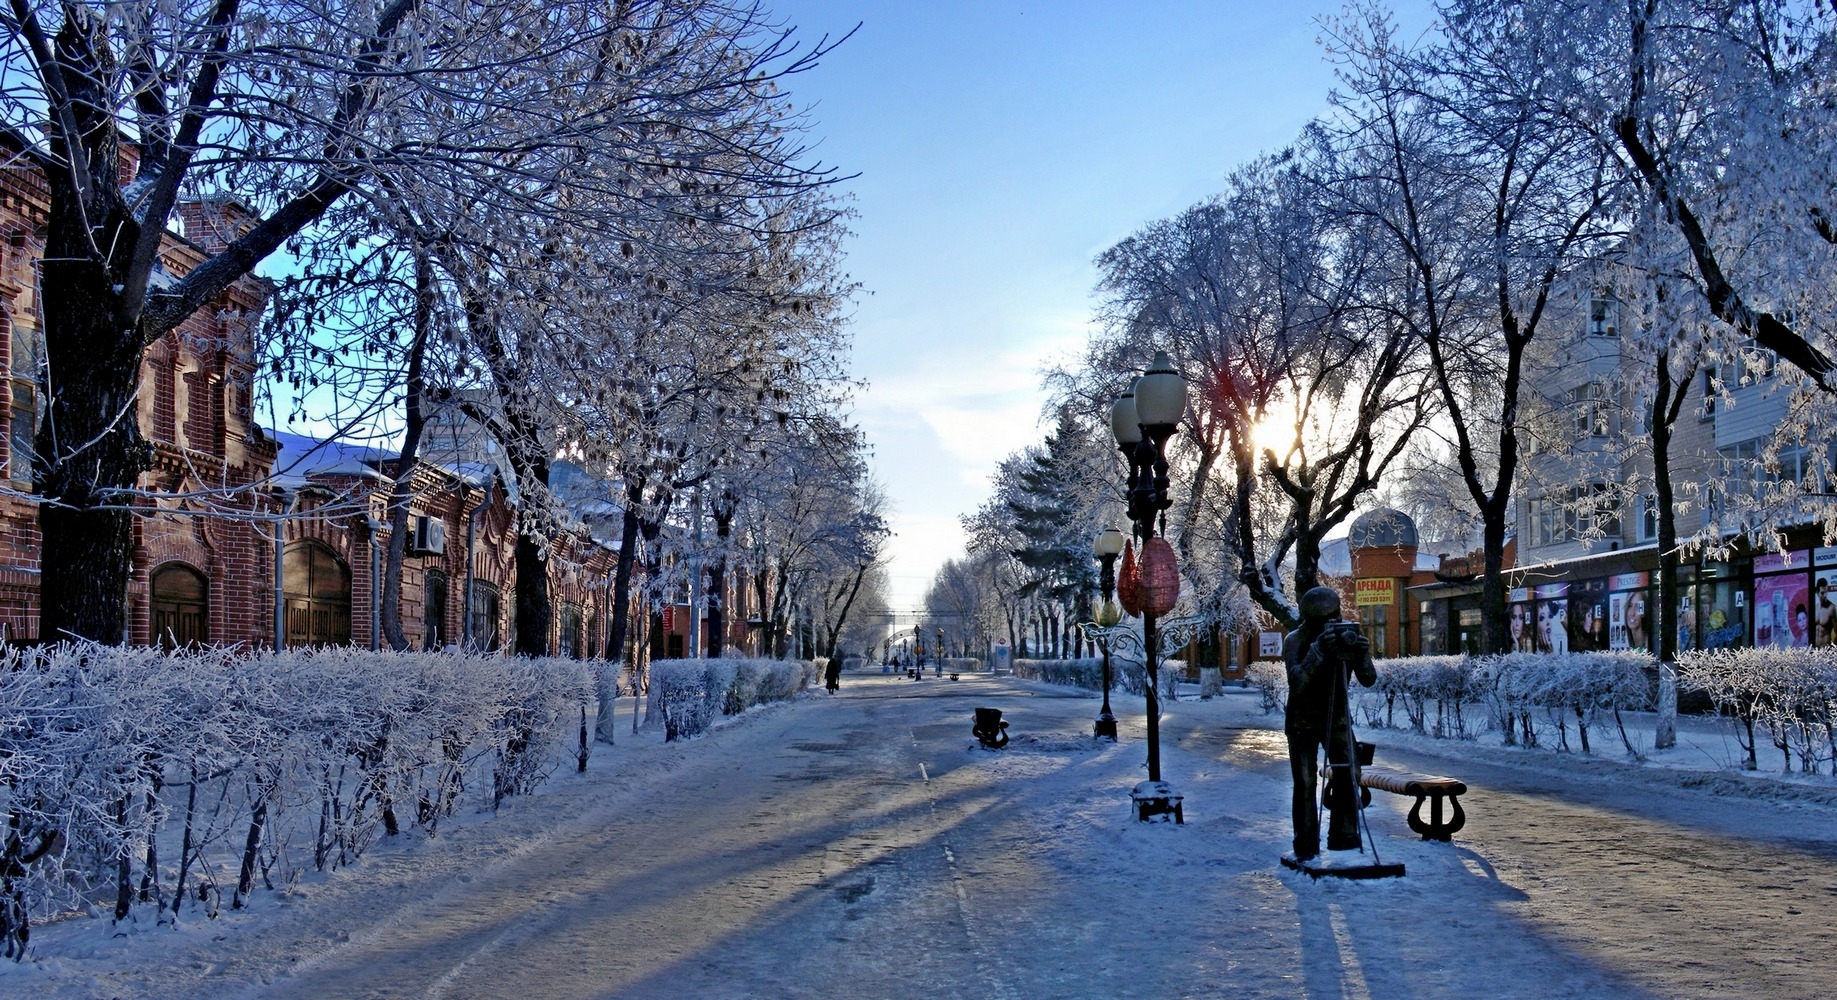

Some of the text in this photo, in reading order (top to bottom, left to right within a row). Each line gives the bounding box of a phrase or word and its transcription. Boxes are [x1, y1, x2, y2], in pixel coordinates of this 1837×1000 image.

[1357, 580, 1392, 592] АРЕНДА
[1617, 576, 1641, 586] PRESTIGE
[1737, 593, 1743, 605] А
